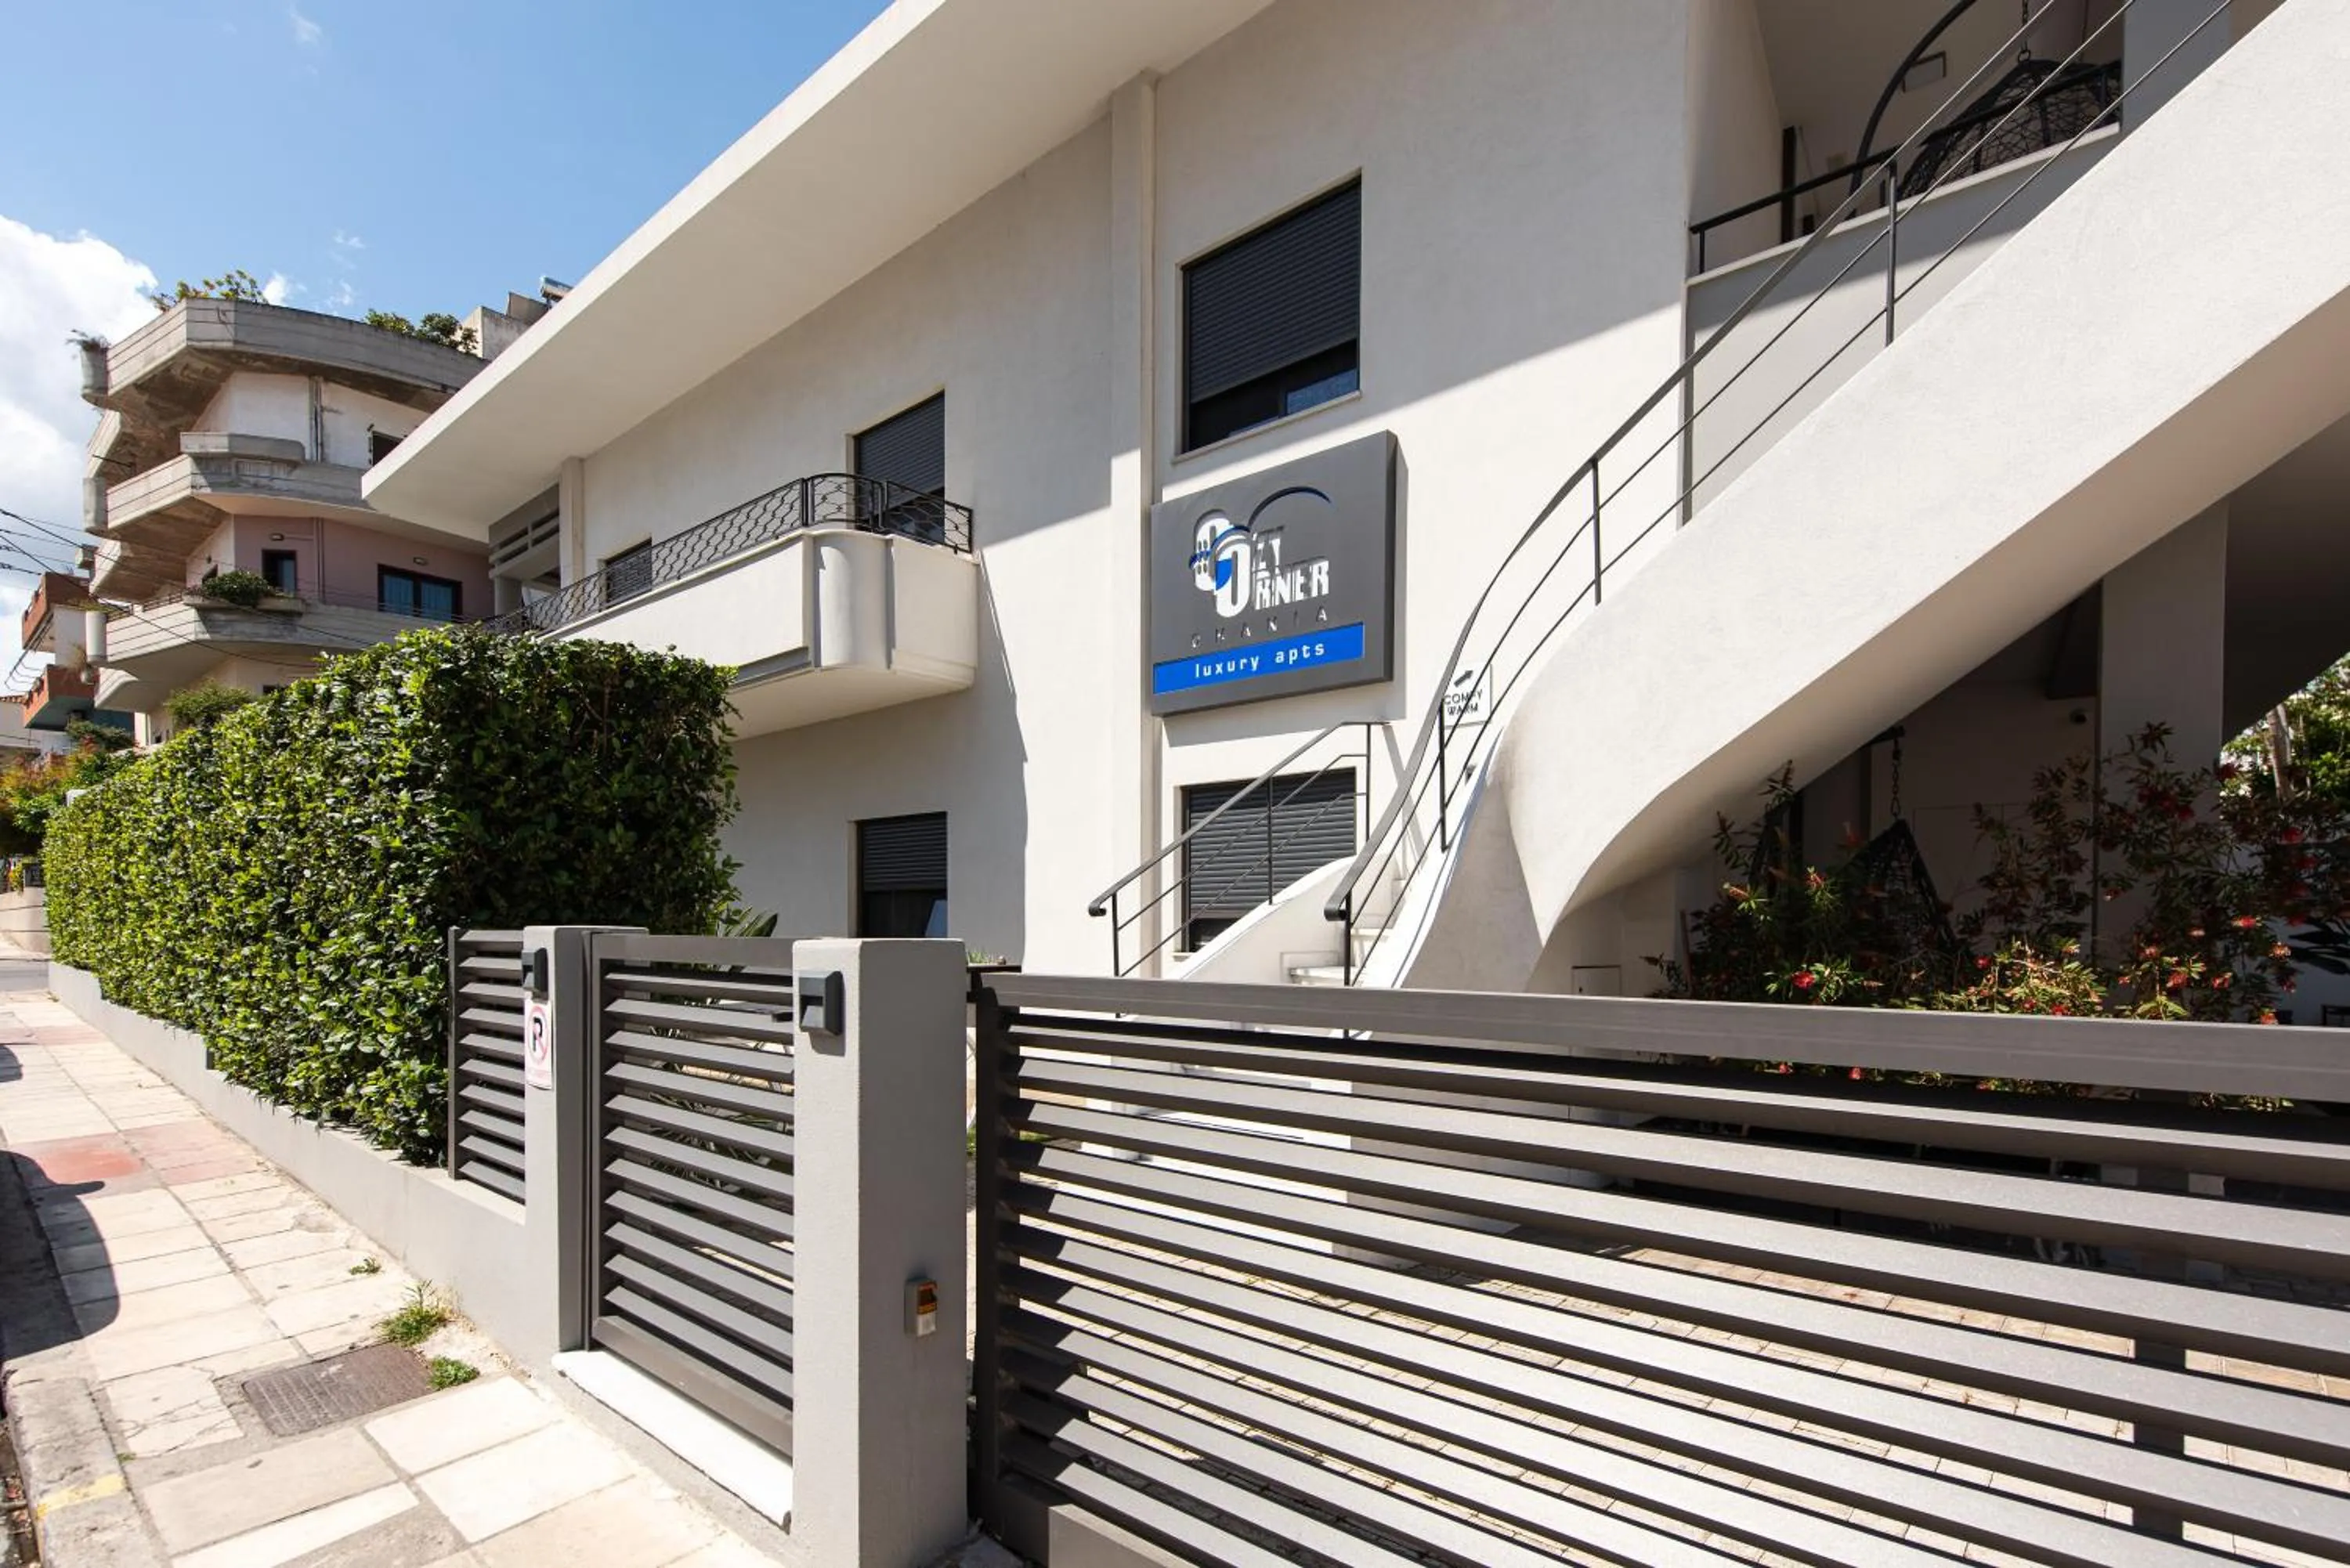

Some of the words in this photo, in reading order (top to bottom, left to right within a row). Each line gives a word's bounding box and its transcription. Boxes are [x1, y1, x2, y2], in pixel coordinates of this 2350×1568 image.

[1195, 656, 1259, 678] luxury
[1275, 641, 1325, 664] apts
[1444, 689, 1483, 705] COMY
